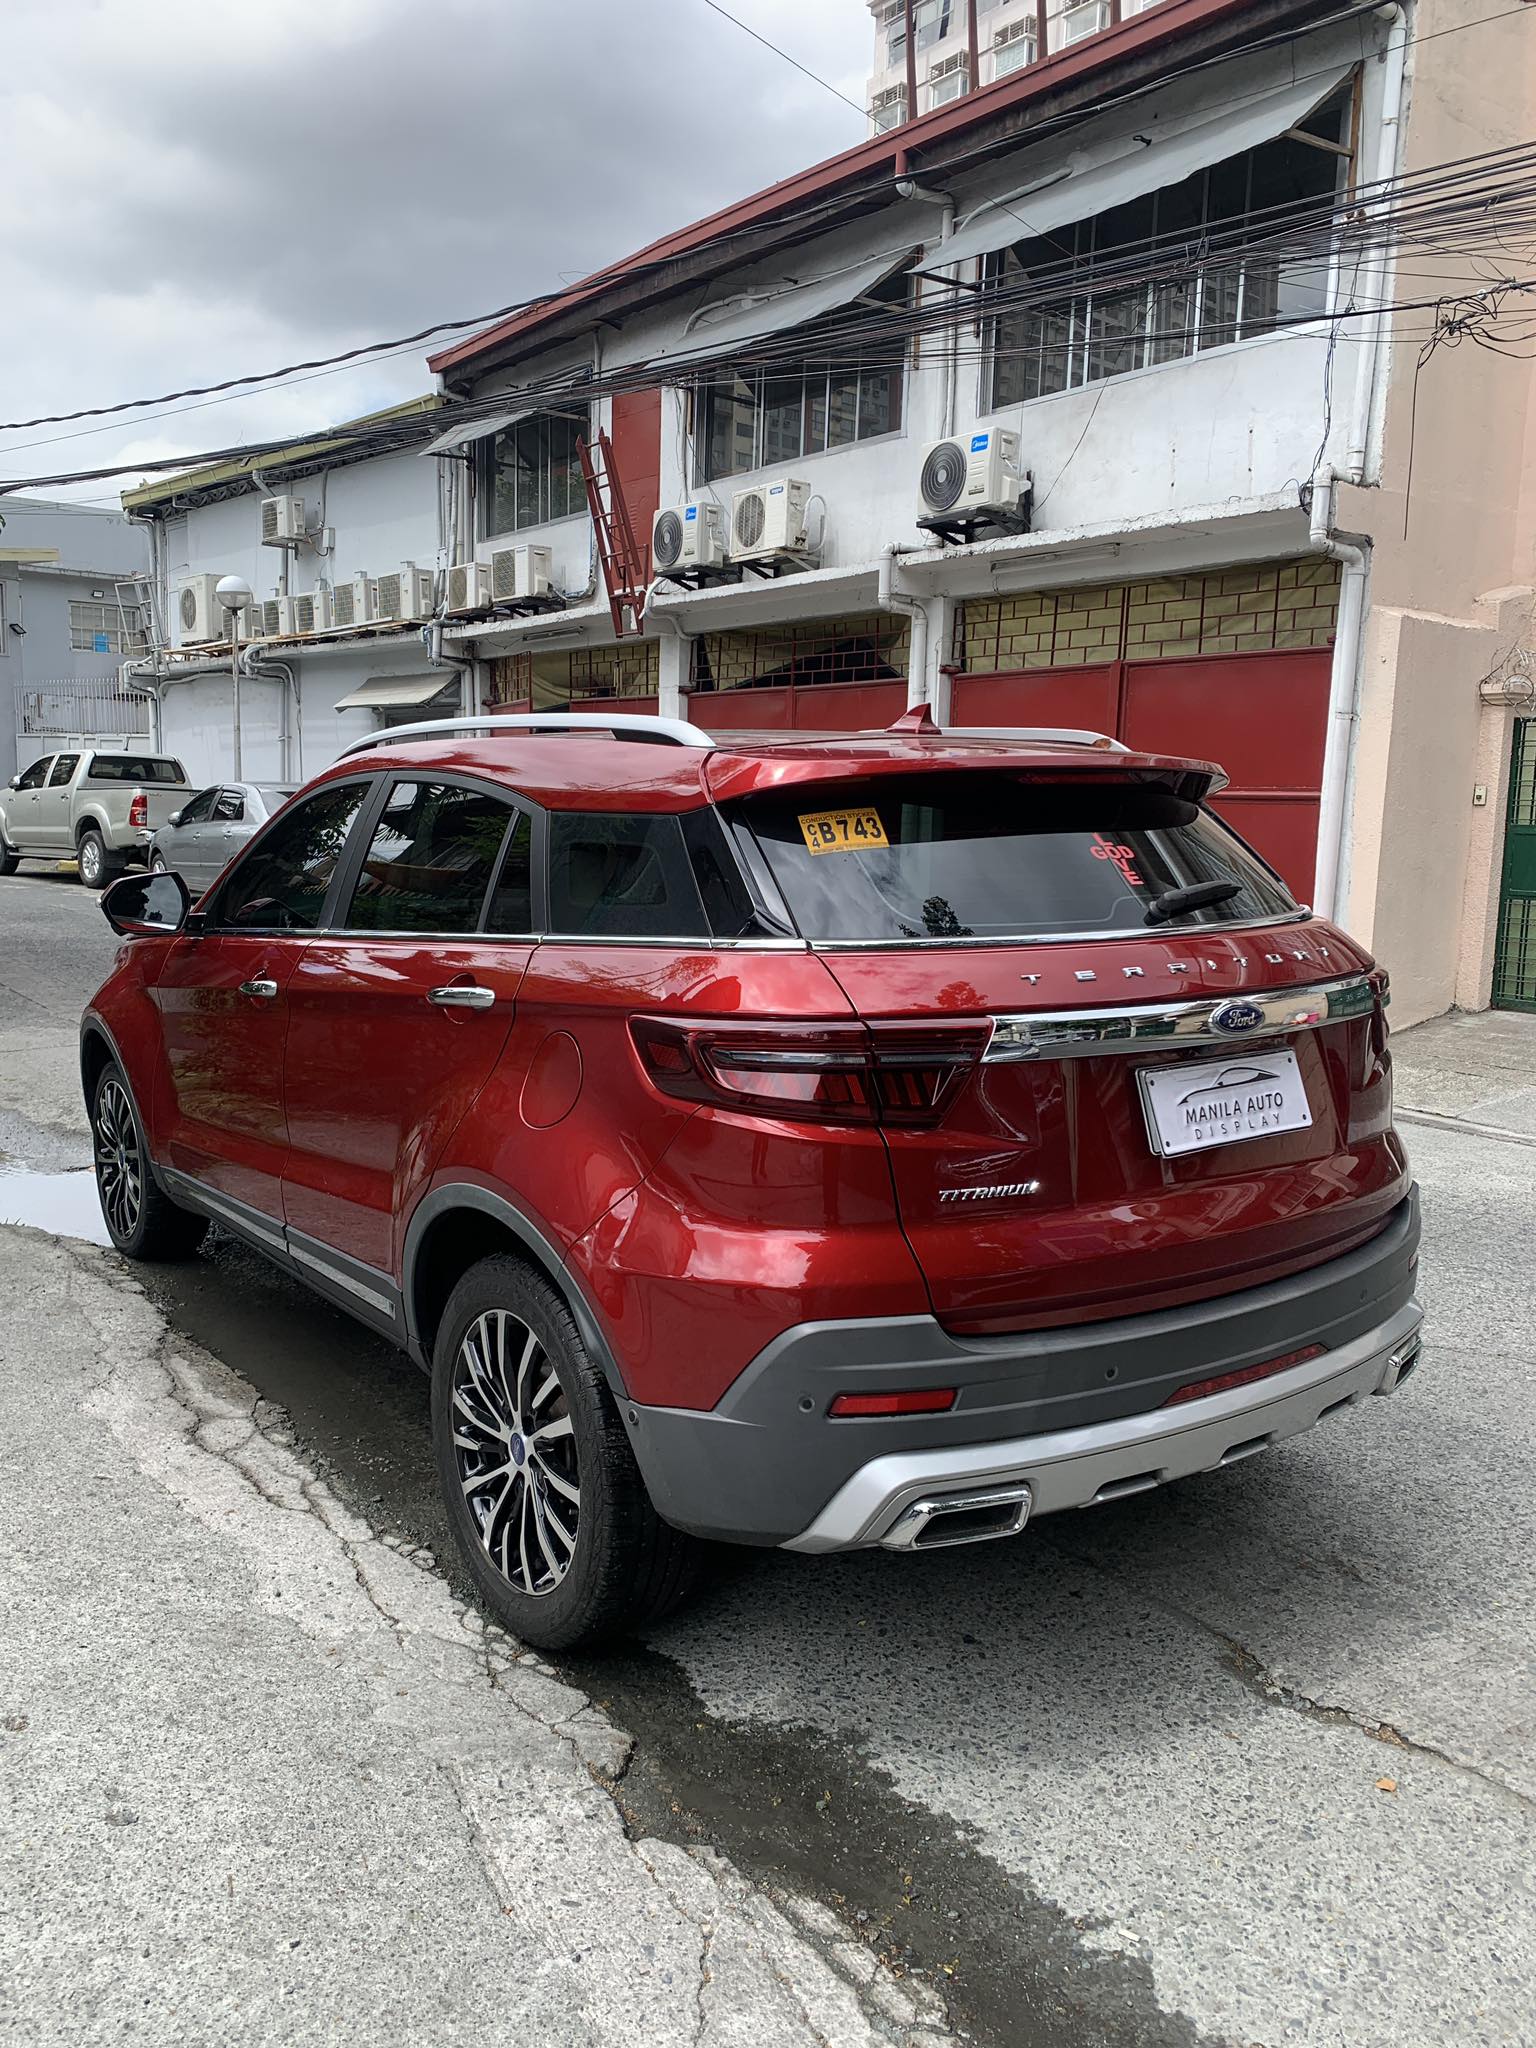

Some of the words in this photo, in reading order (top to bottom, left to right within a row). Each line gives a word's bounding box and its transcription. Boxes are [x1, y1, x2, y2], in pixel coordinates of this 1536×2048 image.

[801, 814, 846, 824] CONDUCTION
[1228, 1009, 1256, 1027] Ford
[1186, 1100, 1242, 1124] MANILA
[1247, 1092, 1283, 1113] AUTO
[1195, 1113, 1280, 1140] DISPLAY
